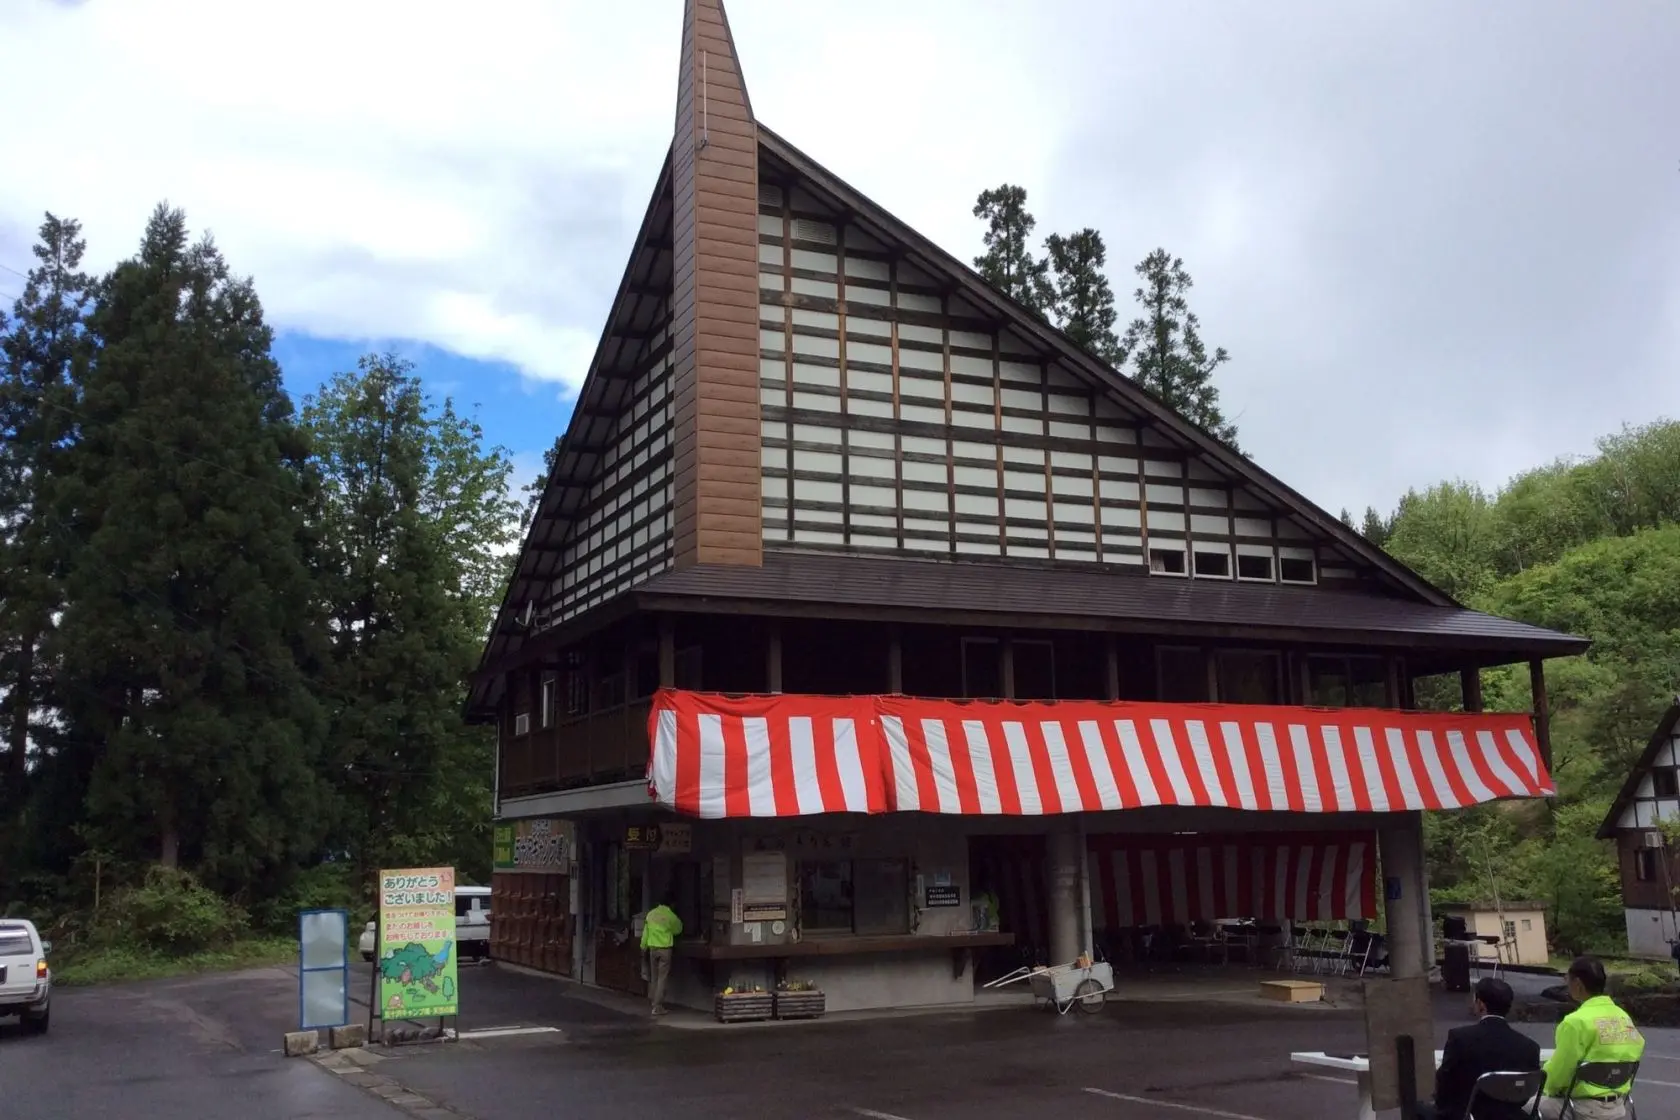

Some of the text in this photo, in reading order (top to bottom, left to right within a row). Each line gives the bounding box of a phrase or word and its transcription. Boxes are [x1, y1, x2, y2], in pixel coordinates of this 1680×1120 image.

[384, 876, 439, 889] ありがとう
